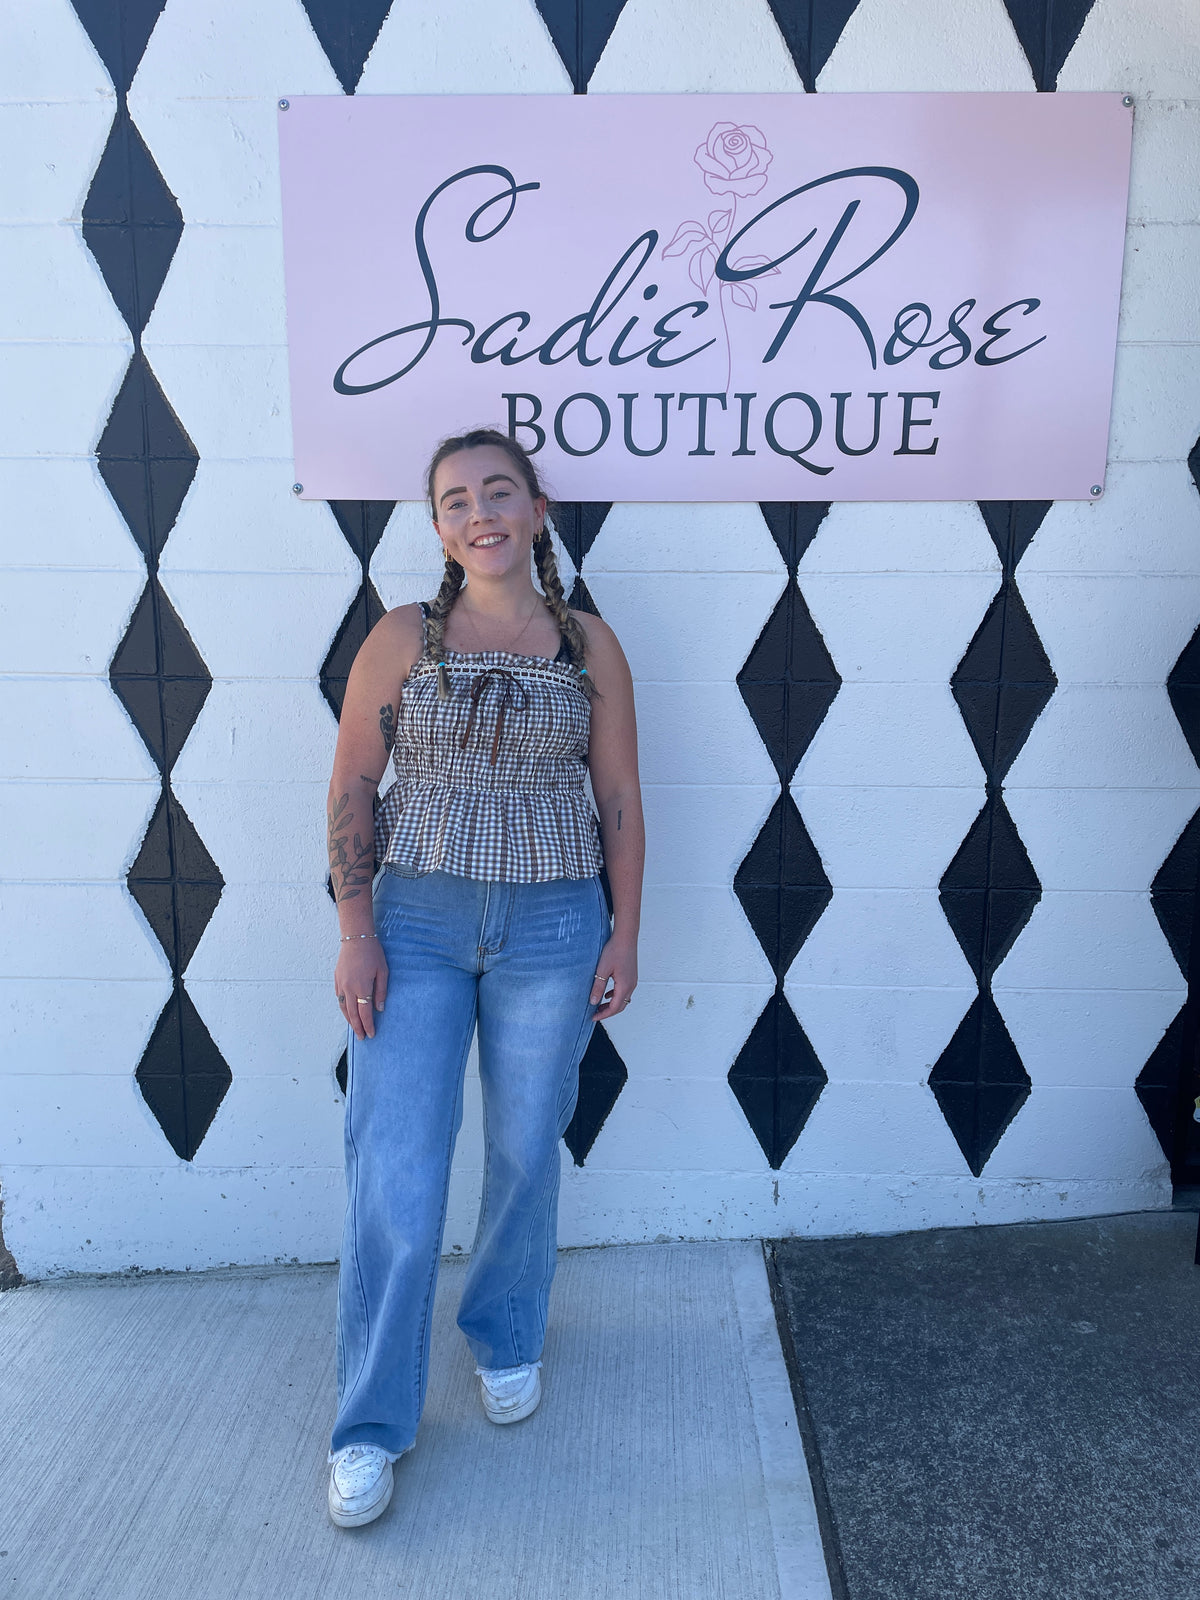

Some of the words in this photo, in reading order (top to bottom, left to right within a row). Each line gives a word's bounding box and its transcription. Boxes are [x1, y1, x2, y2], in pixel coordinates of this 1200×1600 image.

[334, 164, 717, 396] Sadie
[714, 166, 1047, 371] Rose
[501, 392, 941, 476] BOUTIQUE
